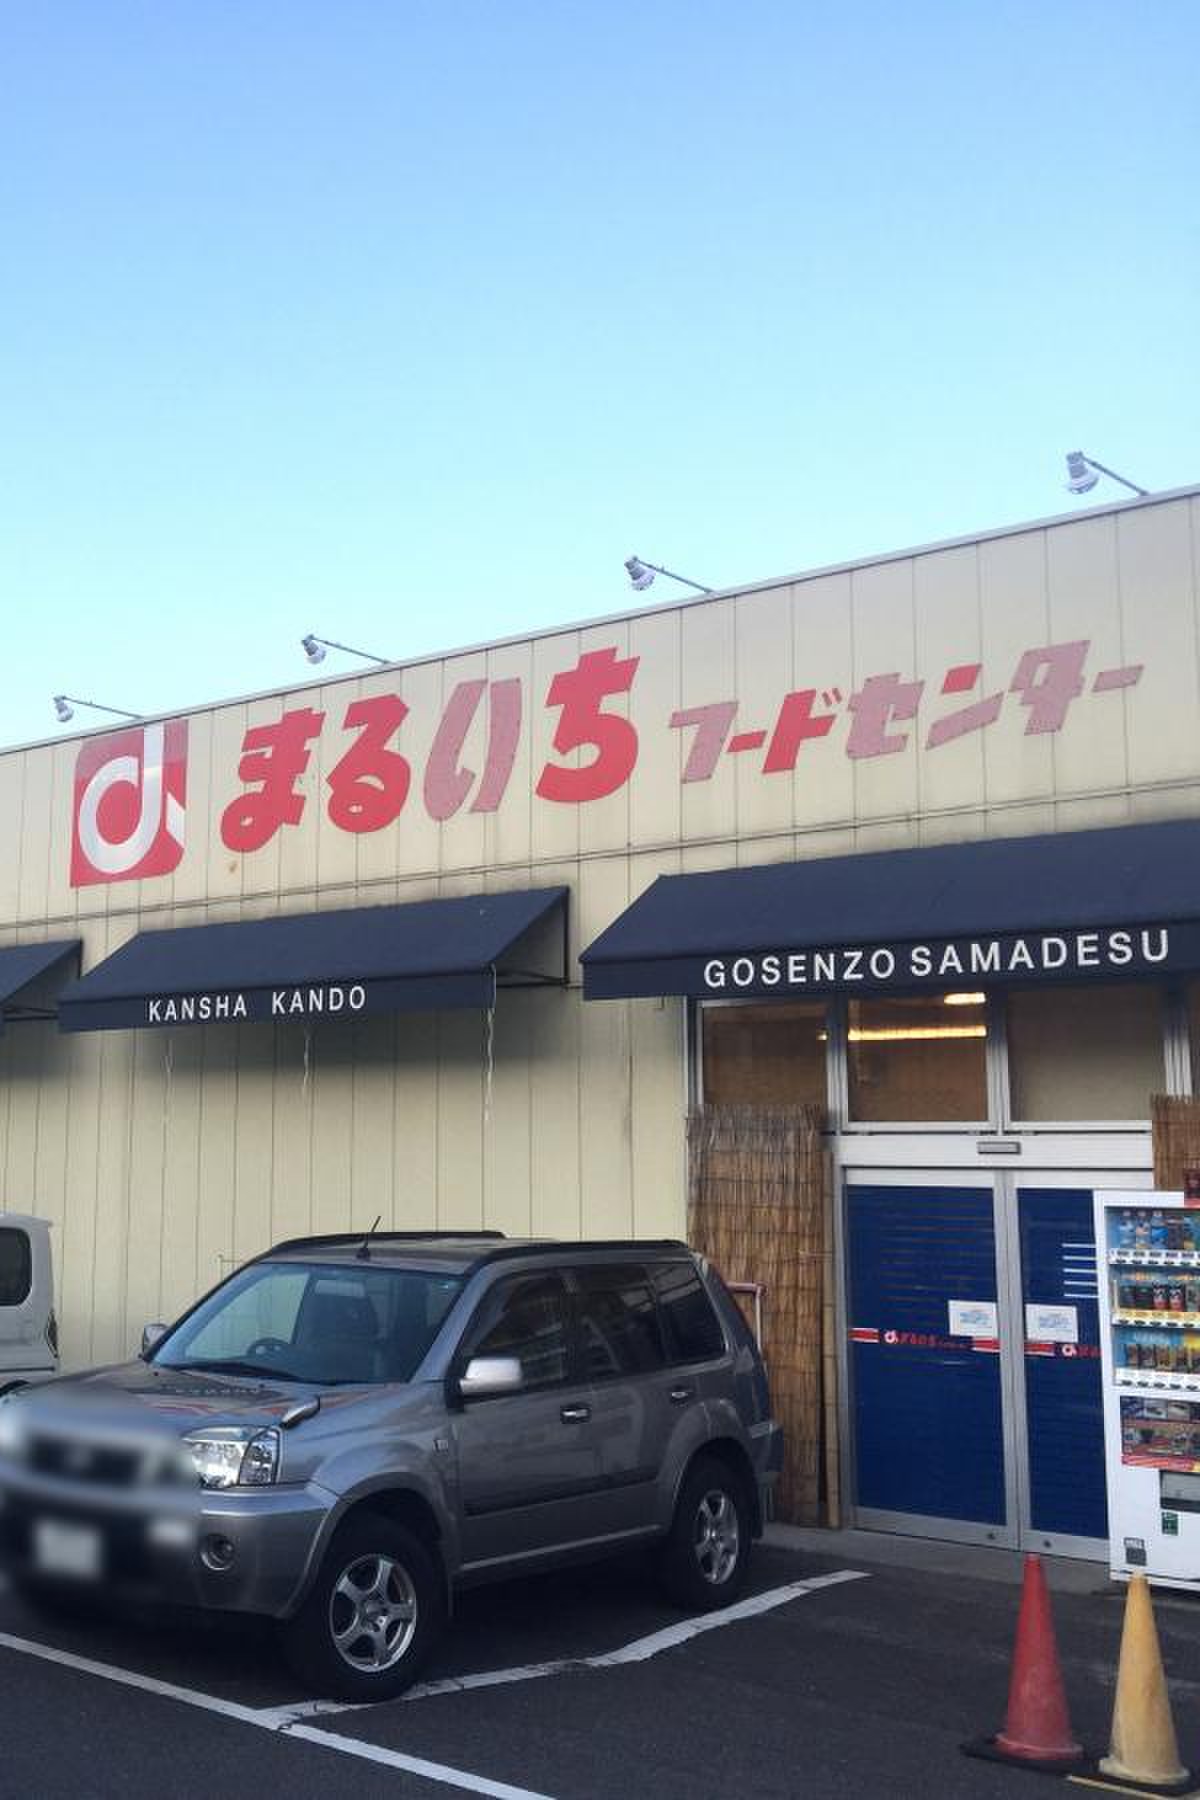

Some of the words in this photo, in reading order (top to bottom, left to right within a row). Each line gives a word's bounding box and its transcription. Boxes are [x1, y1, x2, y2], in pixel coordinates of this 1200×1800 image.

[220, 647, 641, 853] まるいち
[668, 640, 1144, 784] フードセンター
[703, 948, 896, 988] GOSENZO
[910, 929, 1170, 977] SAMADESU
[149, 994, 248, 1023] KANSHA
[271, 985, 367, 1015] KANDO
